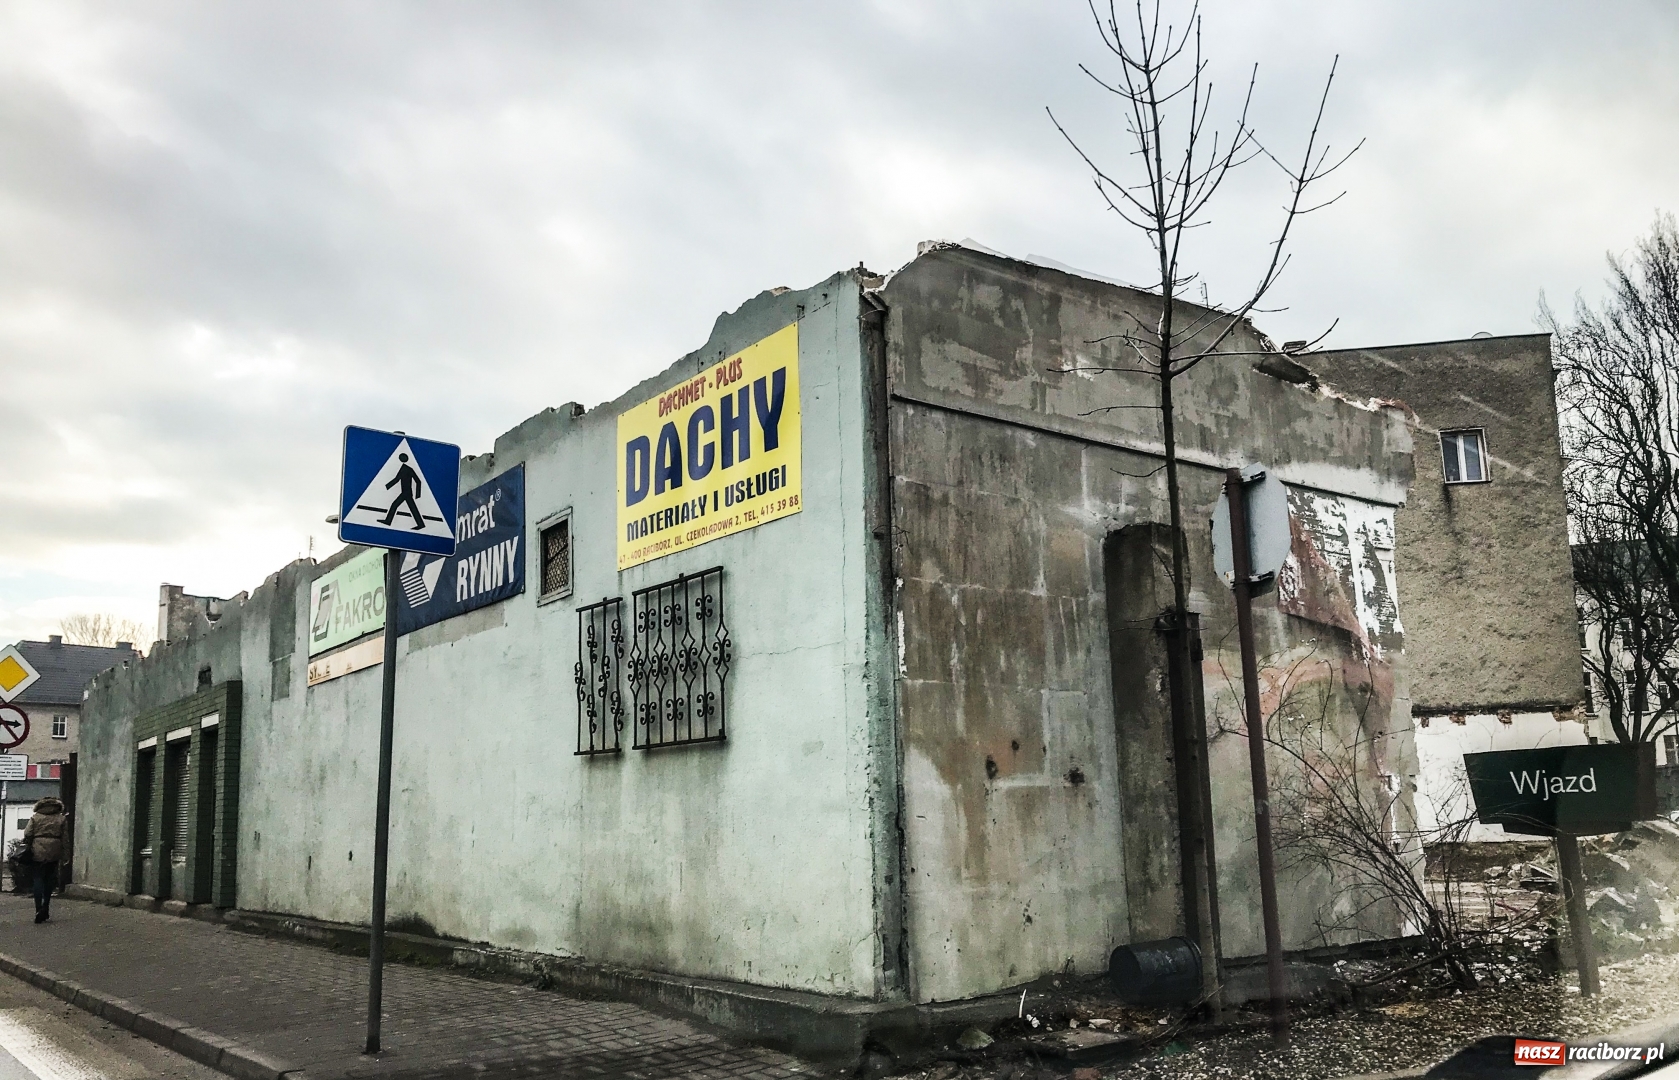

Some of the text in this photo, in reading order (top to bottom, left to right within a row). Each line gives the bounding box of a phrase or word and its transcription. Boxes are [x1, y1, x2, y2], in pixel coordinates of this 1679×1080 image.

[659, 357, 742, 417] DACHMET PLUS
[626, 366, 786, 507] DACHY
[627, 464, 786, 542] MATERIAŁY I USŁUGI
[686, 517, 733, 542] CZEKOLADOWA
[761, 503, 774, 516] 415
[777, 499, 786, 511] 39
[789, 494, 798, 508] 88
[456, 535, 519, 603] RYNNY
[334, 586, 385, 634] FAKRO
[1509, 767, 1597, 801] Wjazd
